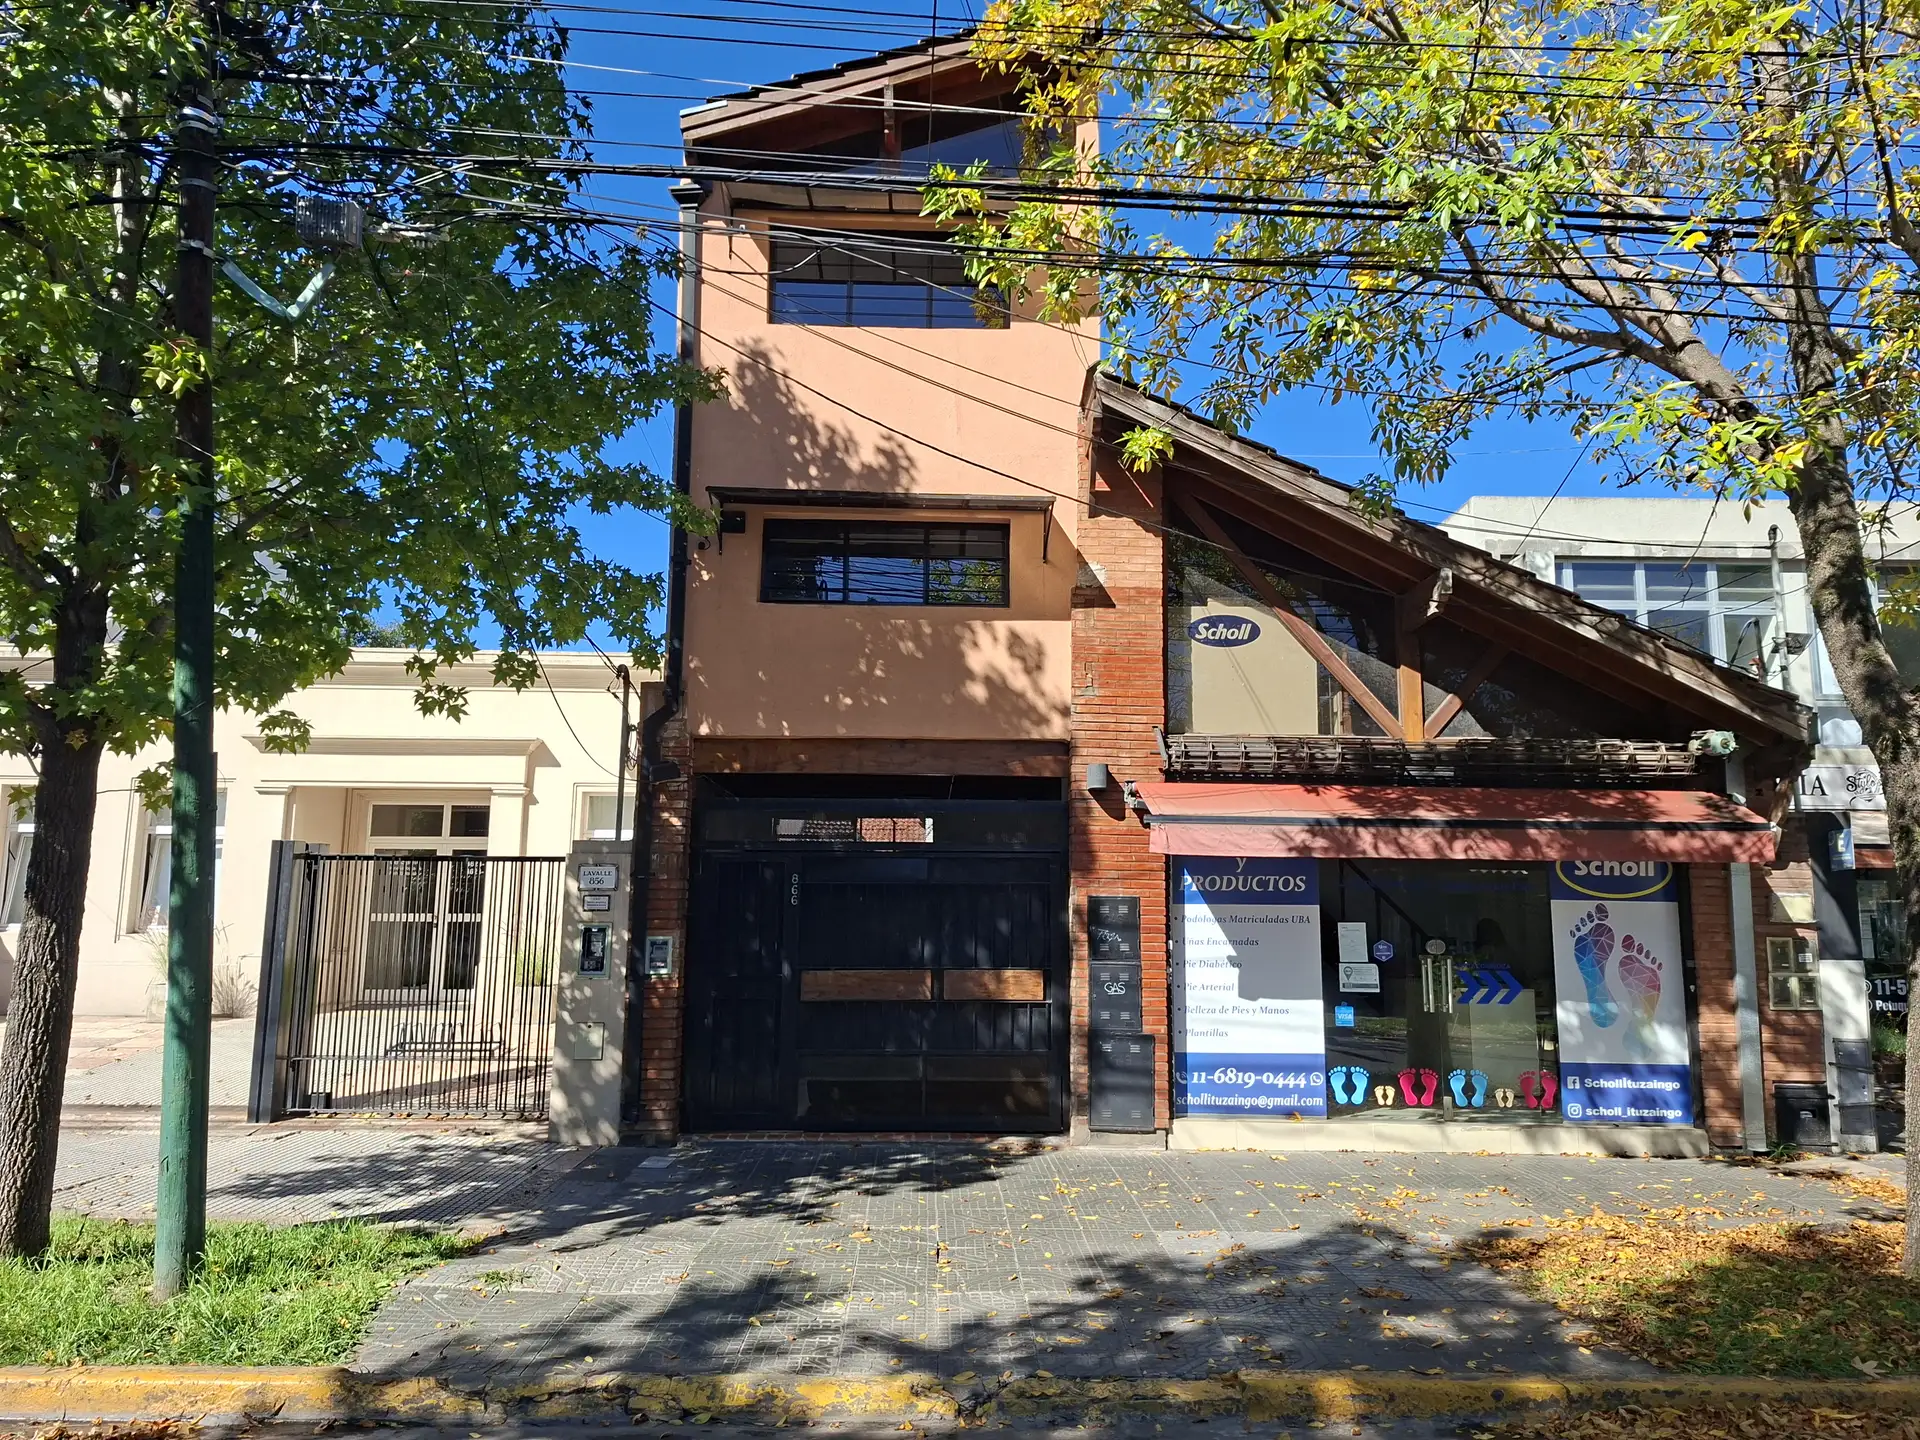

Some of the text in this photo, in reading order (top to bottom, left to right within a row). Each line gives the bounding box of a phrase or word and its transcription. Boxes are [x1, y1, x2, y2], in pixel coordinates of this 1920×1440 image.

[1195, 622, 1252, 640] Scholl
[1235, 857, 1247, 873] y
[589, 877, 604, 885] 856
[1179, 875, 1306, 892] PRODUCTOS
[791, 873, 799, 905] 866
[1229, 915, 1289, 924] Matriculadas
[1291, 915, 1311, 924] UBA
[1182, 936, 1260, 946] Uñas Encarnadas
[1183, 958, 1243, 969] Pie Diabético
[1104, 982, 1126, 995] GAS
[1184, 982, 1235, 992] Pie Arterial
[1184, 1005, 1290, 1016] Belleza de Pies y Manos
[1186, 1028, 1229, 1038] Plantillas
[1191, 1067, 1307, 1089] 11-6819-0444
[1176, 1092, 1324, 1109] schollituzaingo@gmail.com
[1585, 1106, 1683, 1119] scholl_ituzaingo
